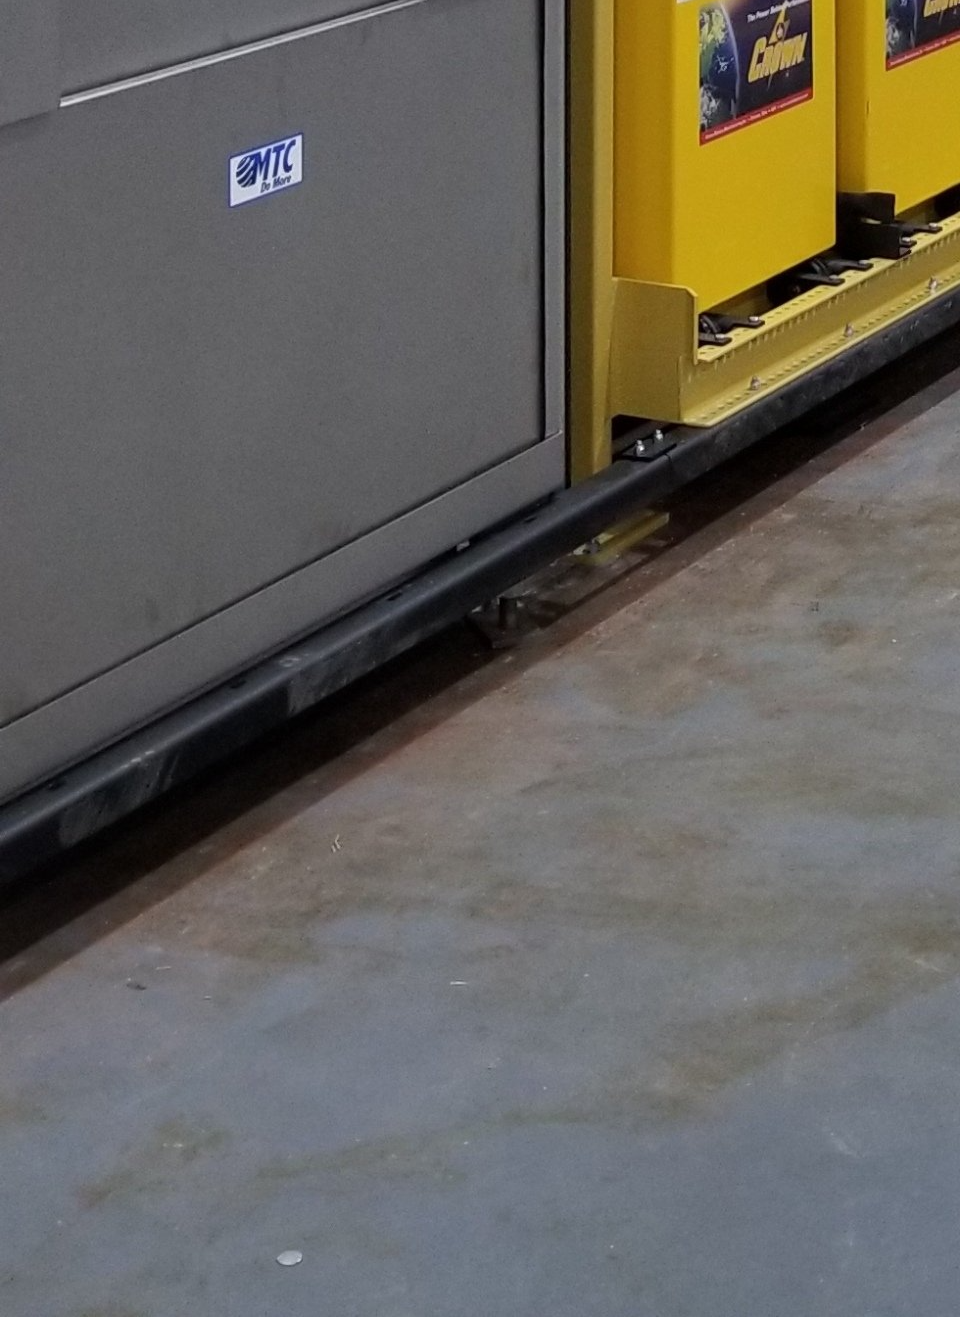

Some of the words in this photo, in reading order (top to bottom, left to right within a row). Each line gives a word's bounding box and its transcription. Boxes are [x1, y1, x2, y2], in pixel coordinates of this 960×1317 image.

[748, 31, 808, 83] CROWN
[250, 138, 297, 186] MTC
[271, 175, 292, 189] More
